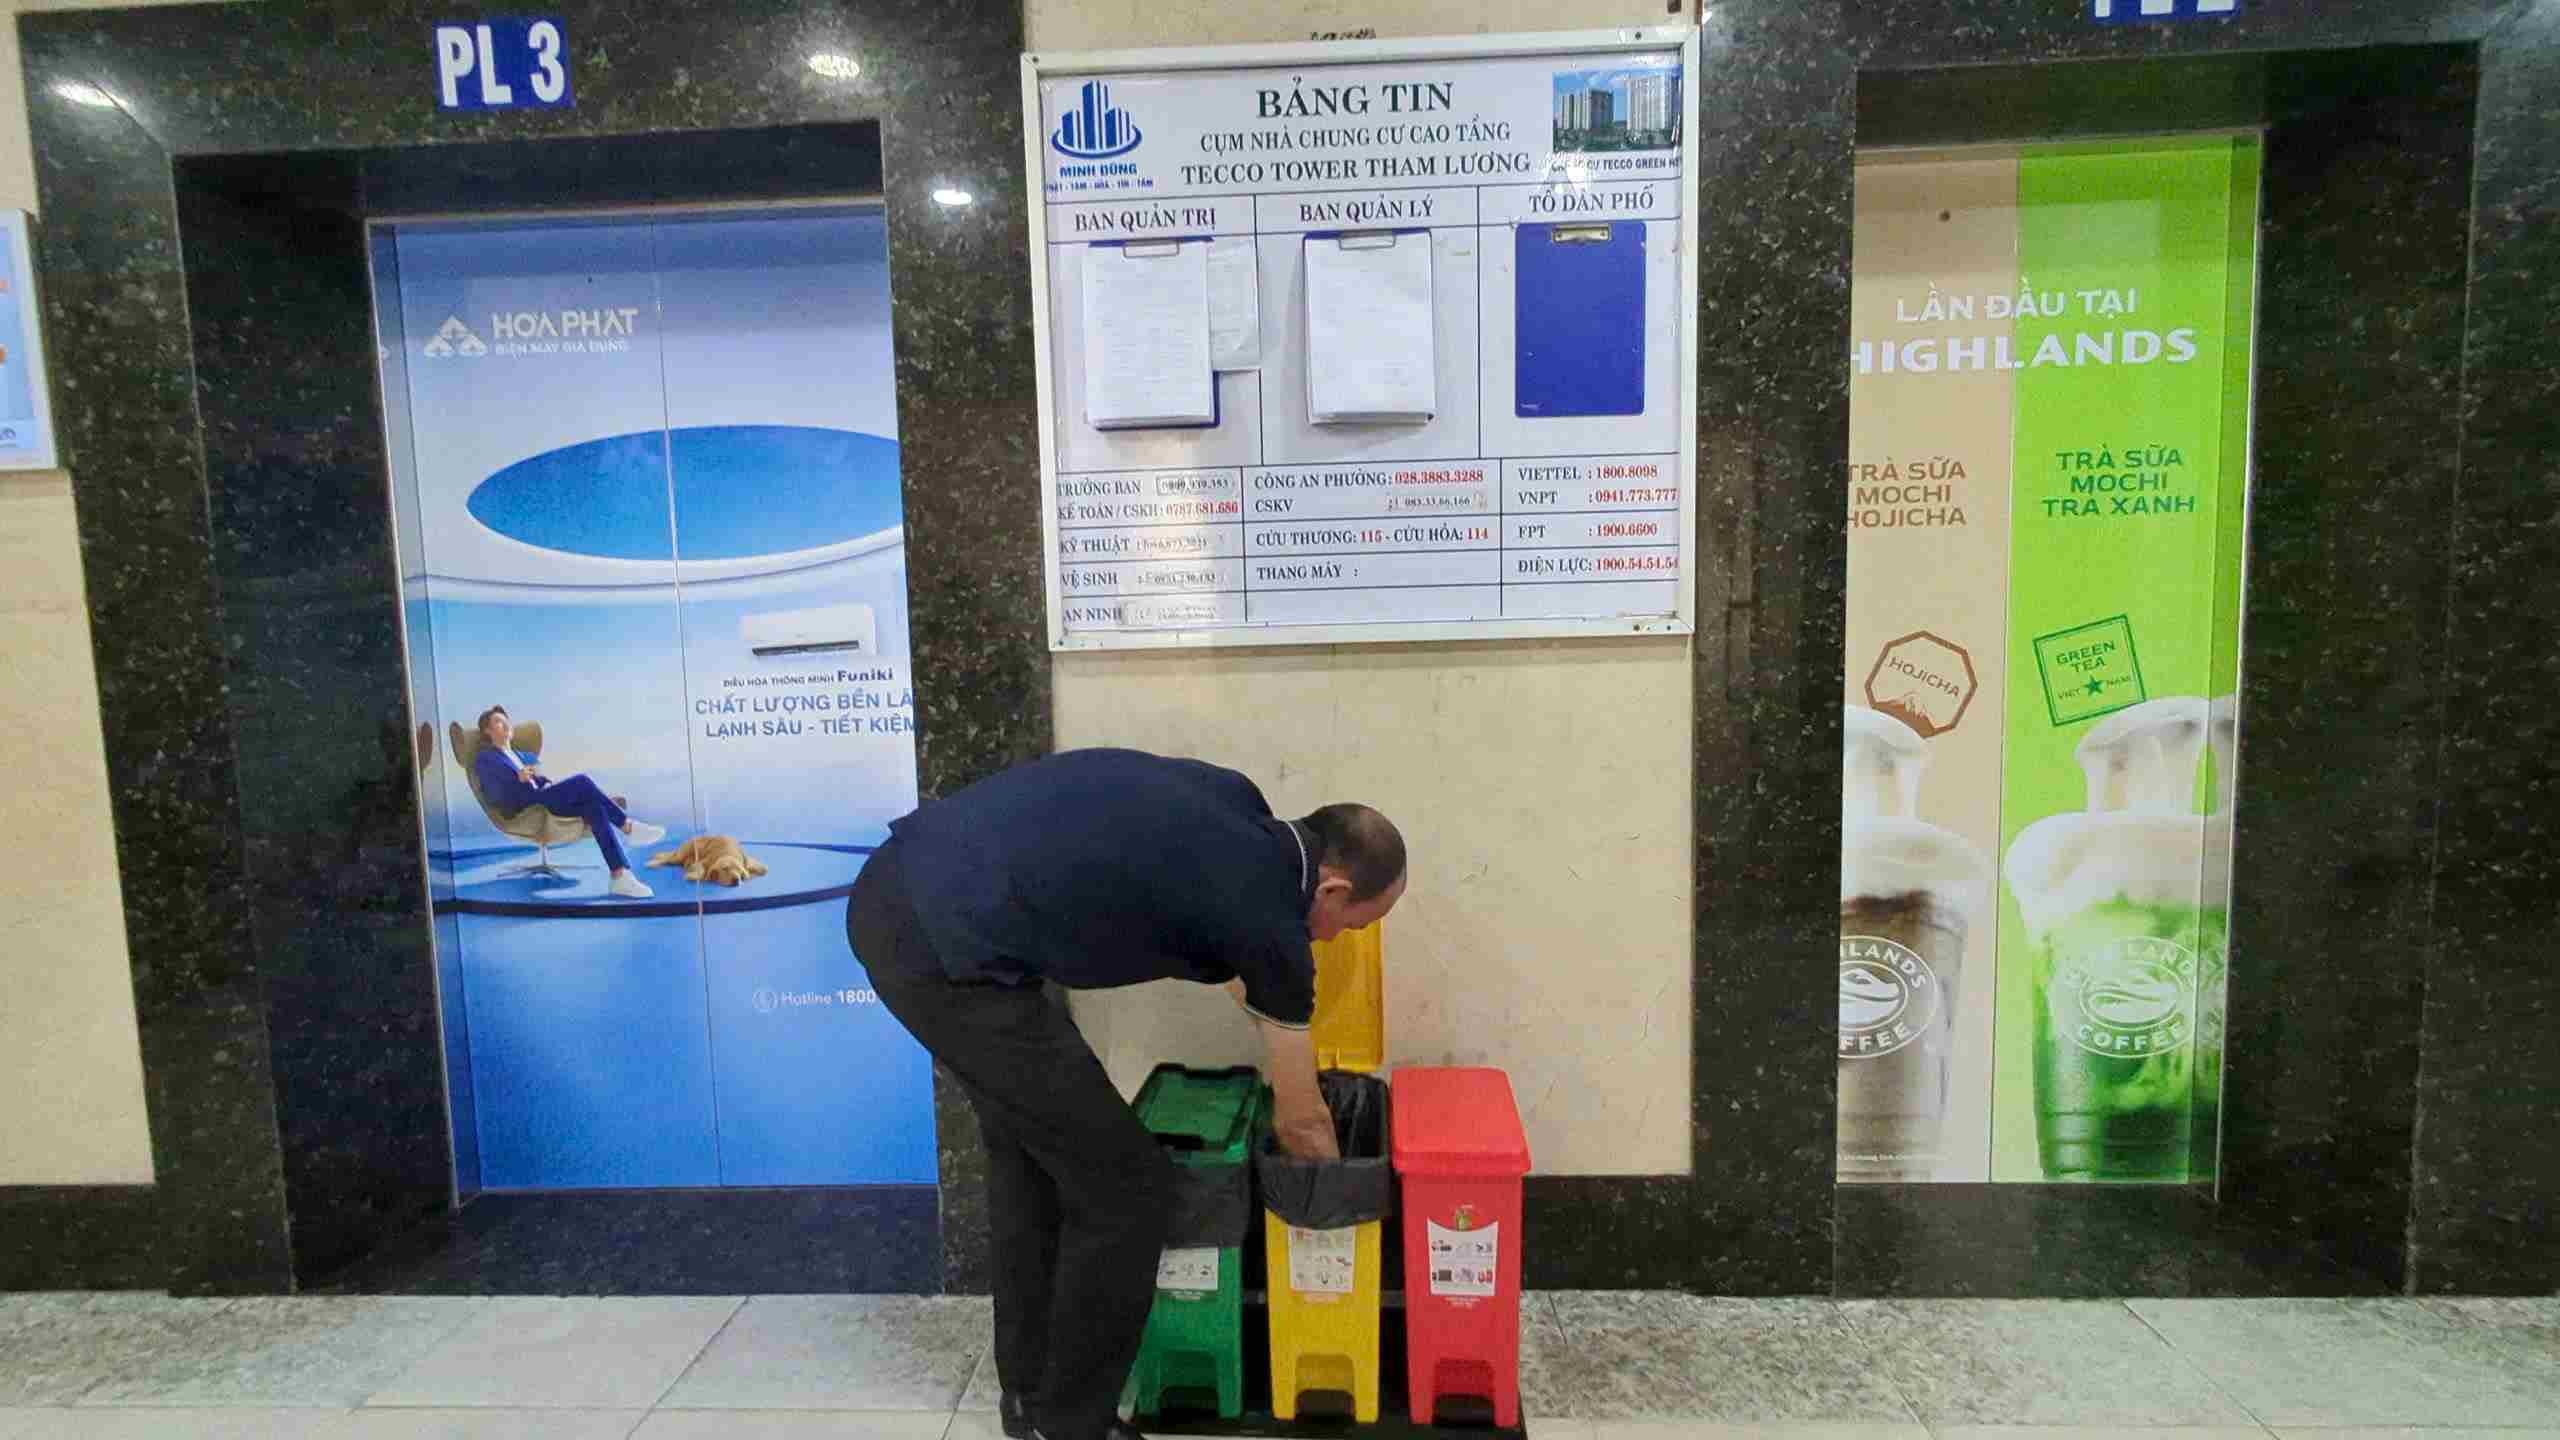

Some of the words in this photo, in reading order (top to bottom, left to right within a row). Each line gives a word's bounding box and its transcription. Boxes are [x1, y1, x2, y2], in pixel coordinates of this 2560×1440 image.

[436, 25, 513, 107] PL
[528, 20, 565, 103] 3
[1256, 76, 1371, 118] BẢNG
[1382, 82, 1454, 112] TIN
[1200, 132, 1244, 156] CỤM
[1299, 128, 1370, 149] CHUNG
[1410, 124, 1450, 144] CAO
[1059, 165, 1096, 177] MINH
[1181, 162, 1264, 185] TECCO
[1270, 160, 1358, 182] TOWER
[1365, 155, 1436, 177] THAM
[1445, 152, 1531, 175] LƯƠNG
[1603, 158, 1633, 170] TECCO
[1635, 157, 1666, 169] GREEN
[1300, 201, 1344, 222] BAN
[1345, 193, 1402, 222] QUẢN
[1409, 193, 1434, 217] LÝ
[1075, 211, 1114, 231] BAN
[1120, 202, 1176, 232] QUẢN
[1182, 207, 1216, 230] TRỊ
[2077, 287, 2139, 319] TẠI
[2056, 443, 2115, 471] TRÀ
[1300, 473, 1319, 488] AN
[1518, 466, 1581, 481] VIETTEL
[1597, 464, 1658, 479] 1800.8098
[1115, 479, 1141, 494] BAN
[2070, 471, 2168, 495] MOCHI
[1518, 491, 1558, 505] VNPT
[1856, 484, 1953, 505] MOCHI
[1123, 503, 1158, 518] CSKH
[1255, 498, 1294, 512] CSKV
[2110, 495, 2195, 516] XANH
[1360, 529, 1383, 543] 115
[1468, 527, 1488, 540] 114
[1518, 525, 1546, 539] FPT
[1597, 523, 1657, 537] 1900.6600
[1083, 572, 1117, 585] SINH
[1064, 608, 1081, 622] AN
[1086, 607, 1122, 621] NINH
[2056, 640, 2116, 665] GREEN
[2071, 657, 2106, 673] TEA
[837, 668, 893, 683] Funiki
[1888, 657, 1960, 697] HOJICHA
[706, 720, 757, 741] LẠNH
[782, 990, 833, 1005] Hotline
[837, 989, 877, 1004] 1800
